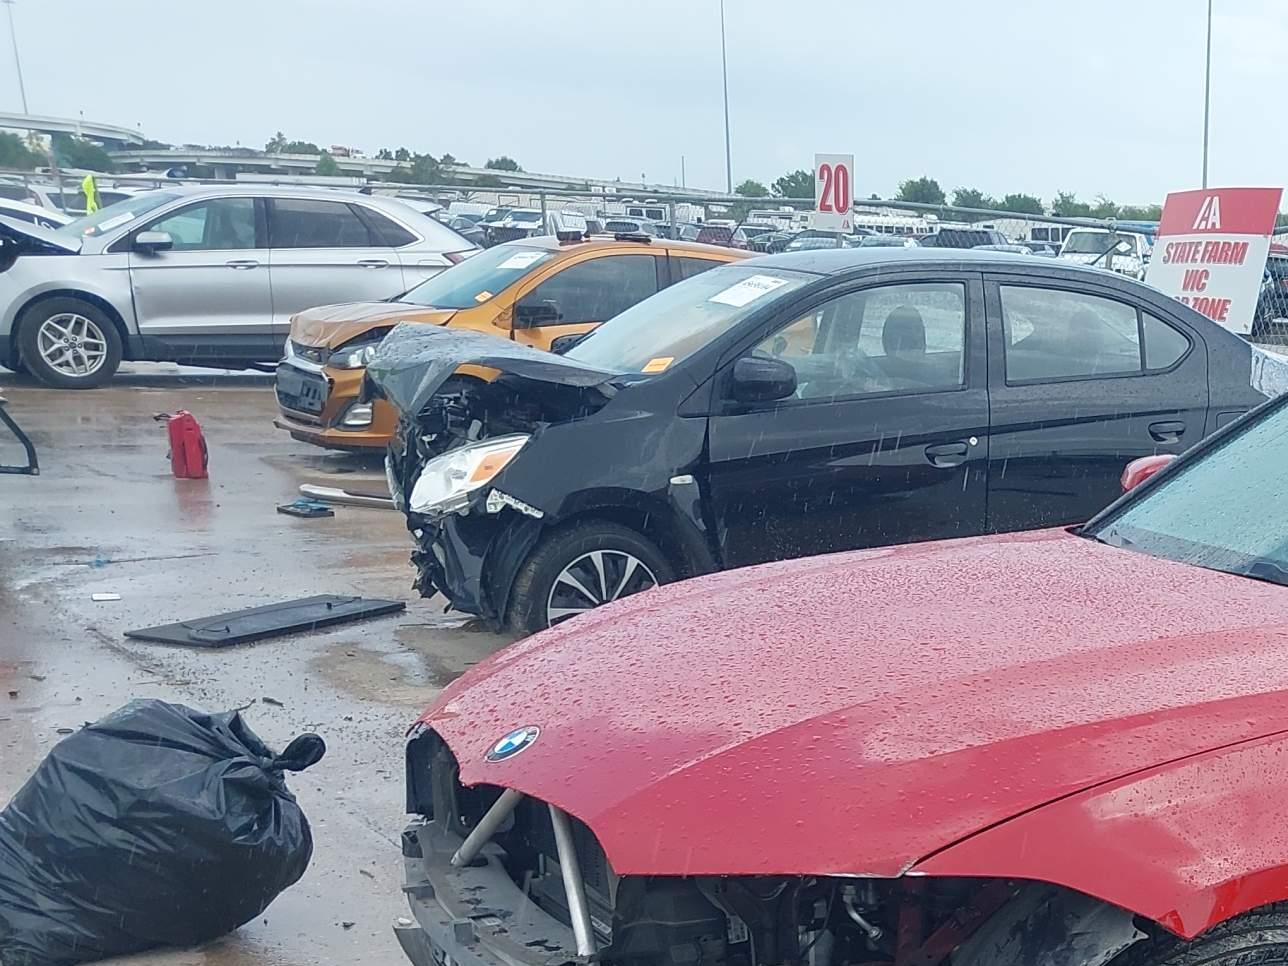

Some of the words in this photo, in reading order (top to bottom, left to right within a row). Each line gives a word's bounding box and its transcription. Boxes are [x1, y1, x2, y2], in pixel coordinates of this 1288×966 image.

[819, 164, 848, 213] 20
[1162, 241, 1203, 265] STATE
[1201, 241, 1249, 266] FARM
[1182, 269, 1210, 292] VIC
